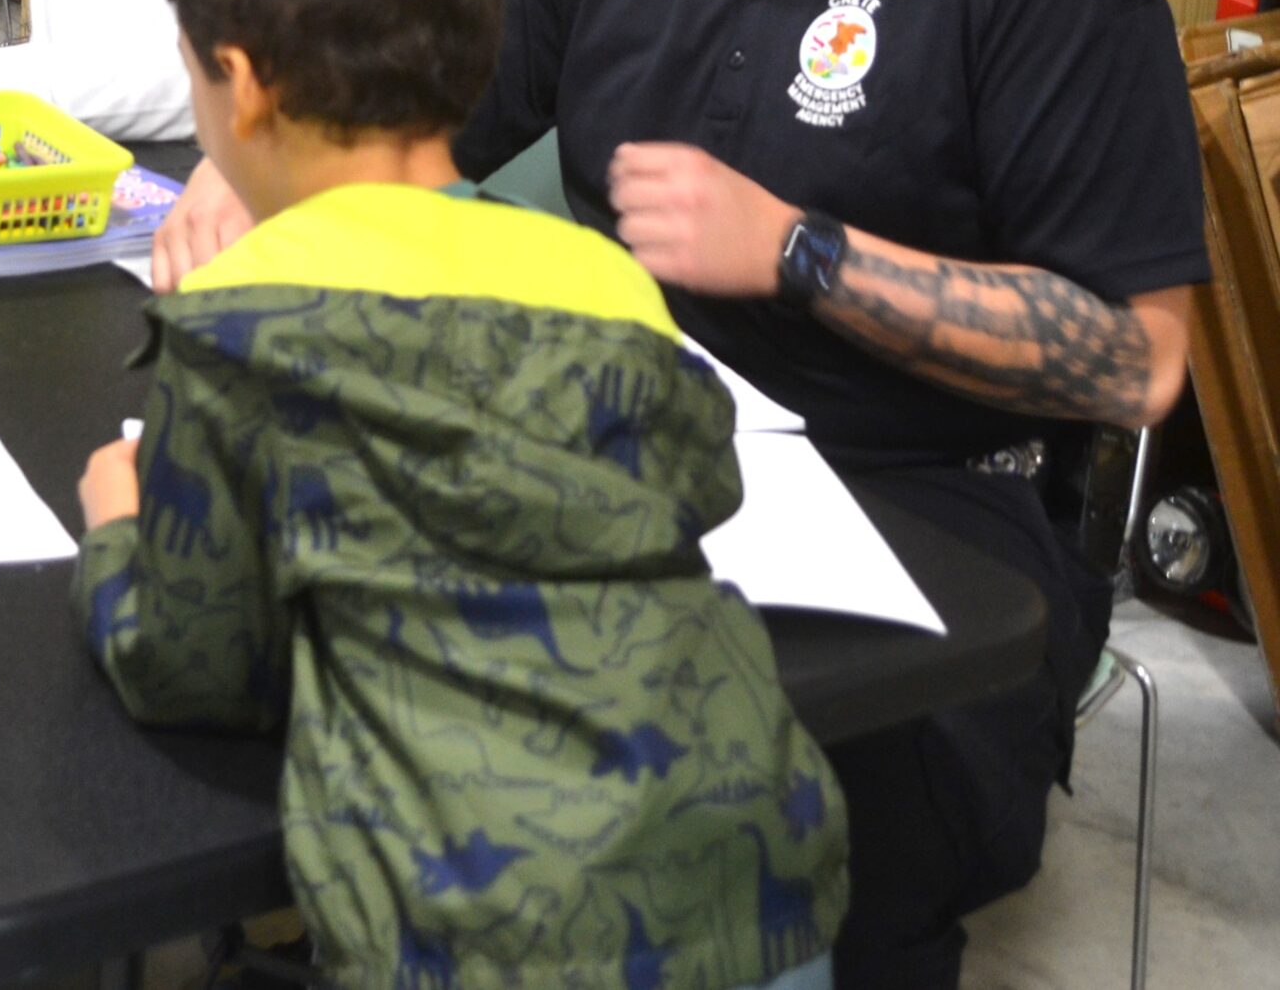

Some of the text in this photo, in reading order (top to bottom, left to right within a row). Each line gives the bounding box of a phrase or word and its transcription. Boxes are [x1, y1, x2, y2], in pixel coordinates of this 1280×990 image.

[787, 82, 867, 114] MANAGEMENT
[794, 71, 864, 102] EMERGENCY
[795, 108, 844, 128] AGENCY
